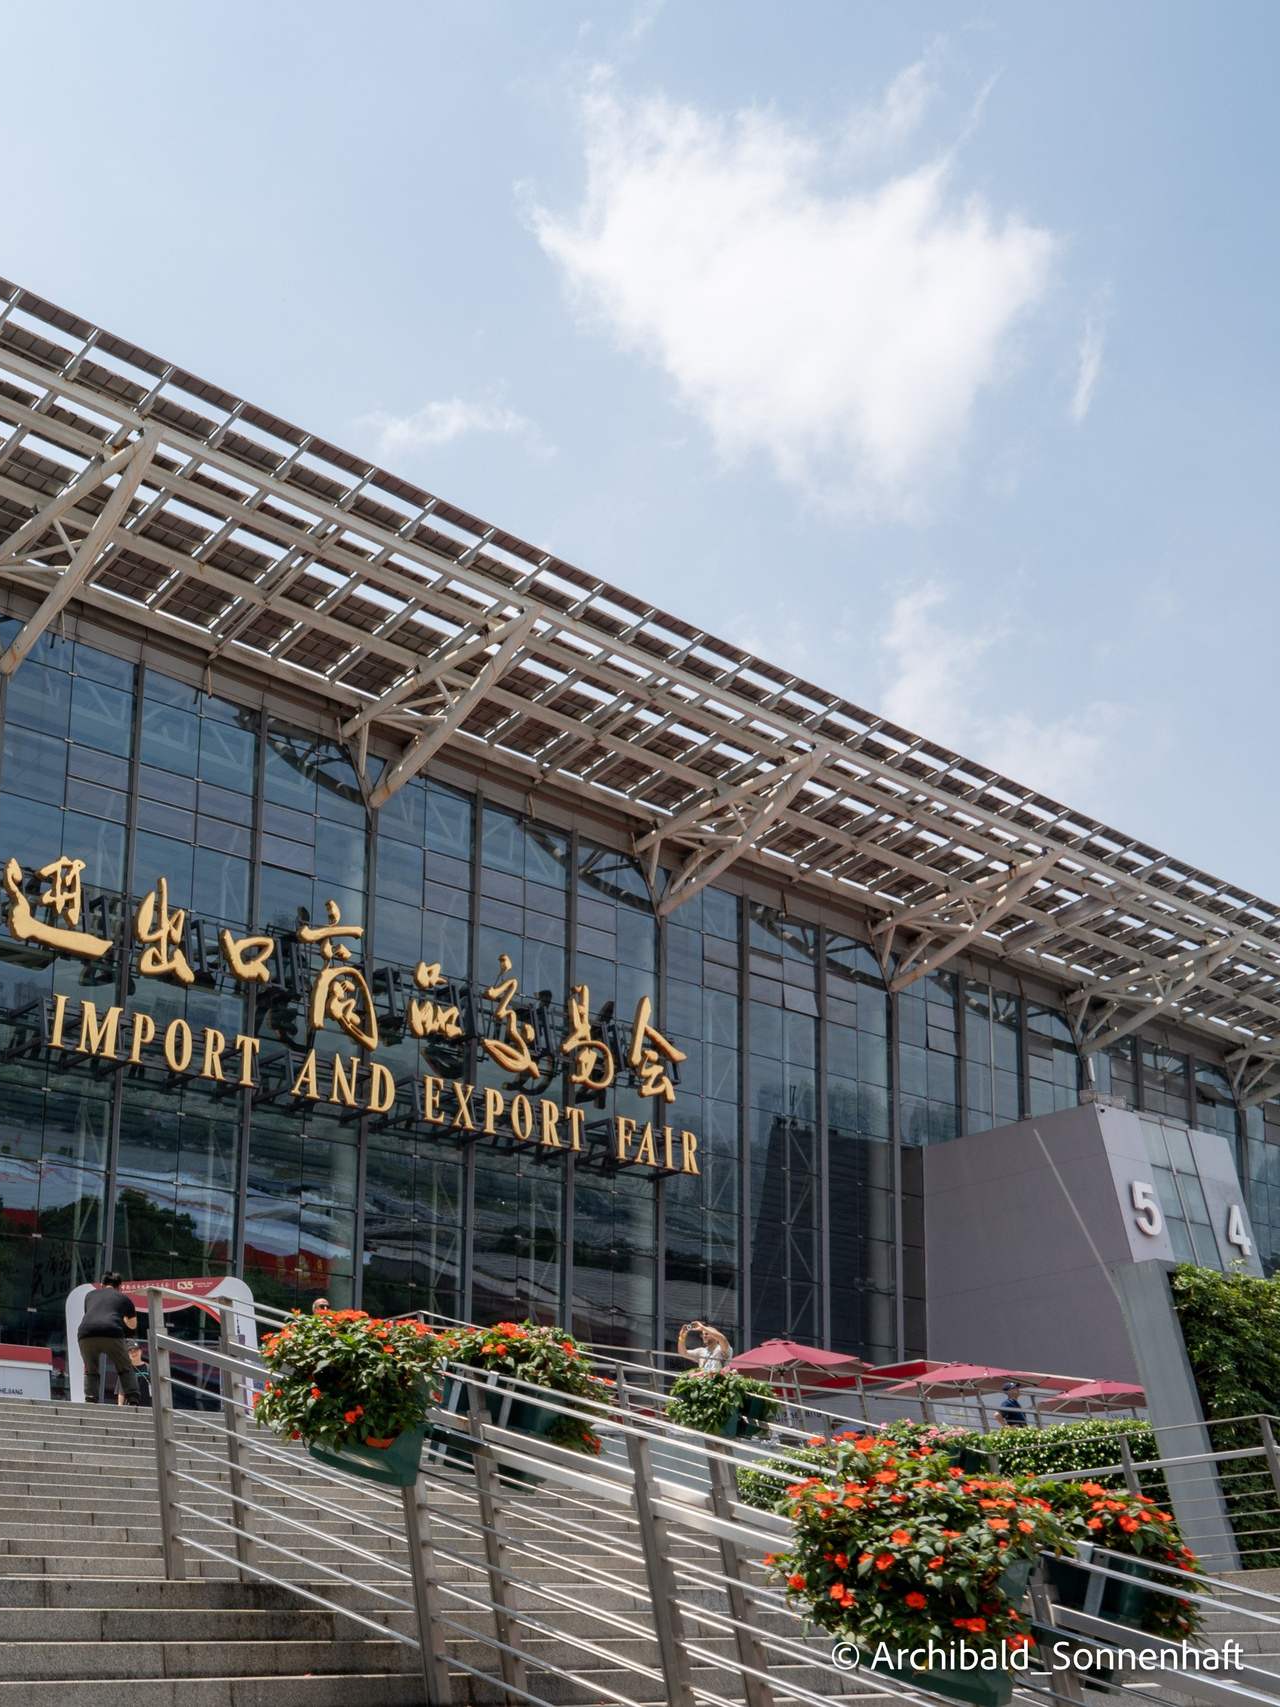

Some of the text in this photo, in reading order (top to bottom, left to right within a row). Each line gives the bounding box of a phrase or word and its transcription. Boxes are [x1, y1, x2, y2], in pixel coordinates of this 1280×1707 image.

[48, 994, 261, 1089] IMPORT
[289, 1048, 396, 1113] AND
[422, 1074, 587, 1154] EXPORT
[613, 1116, 702, 1176] FAIR
[1130, 1180, 1162, 1237] 5
[1227, 1203, 1252, 1256] 4
